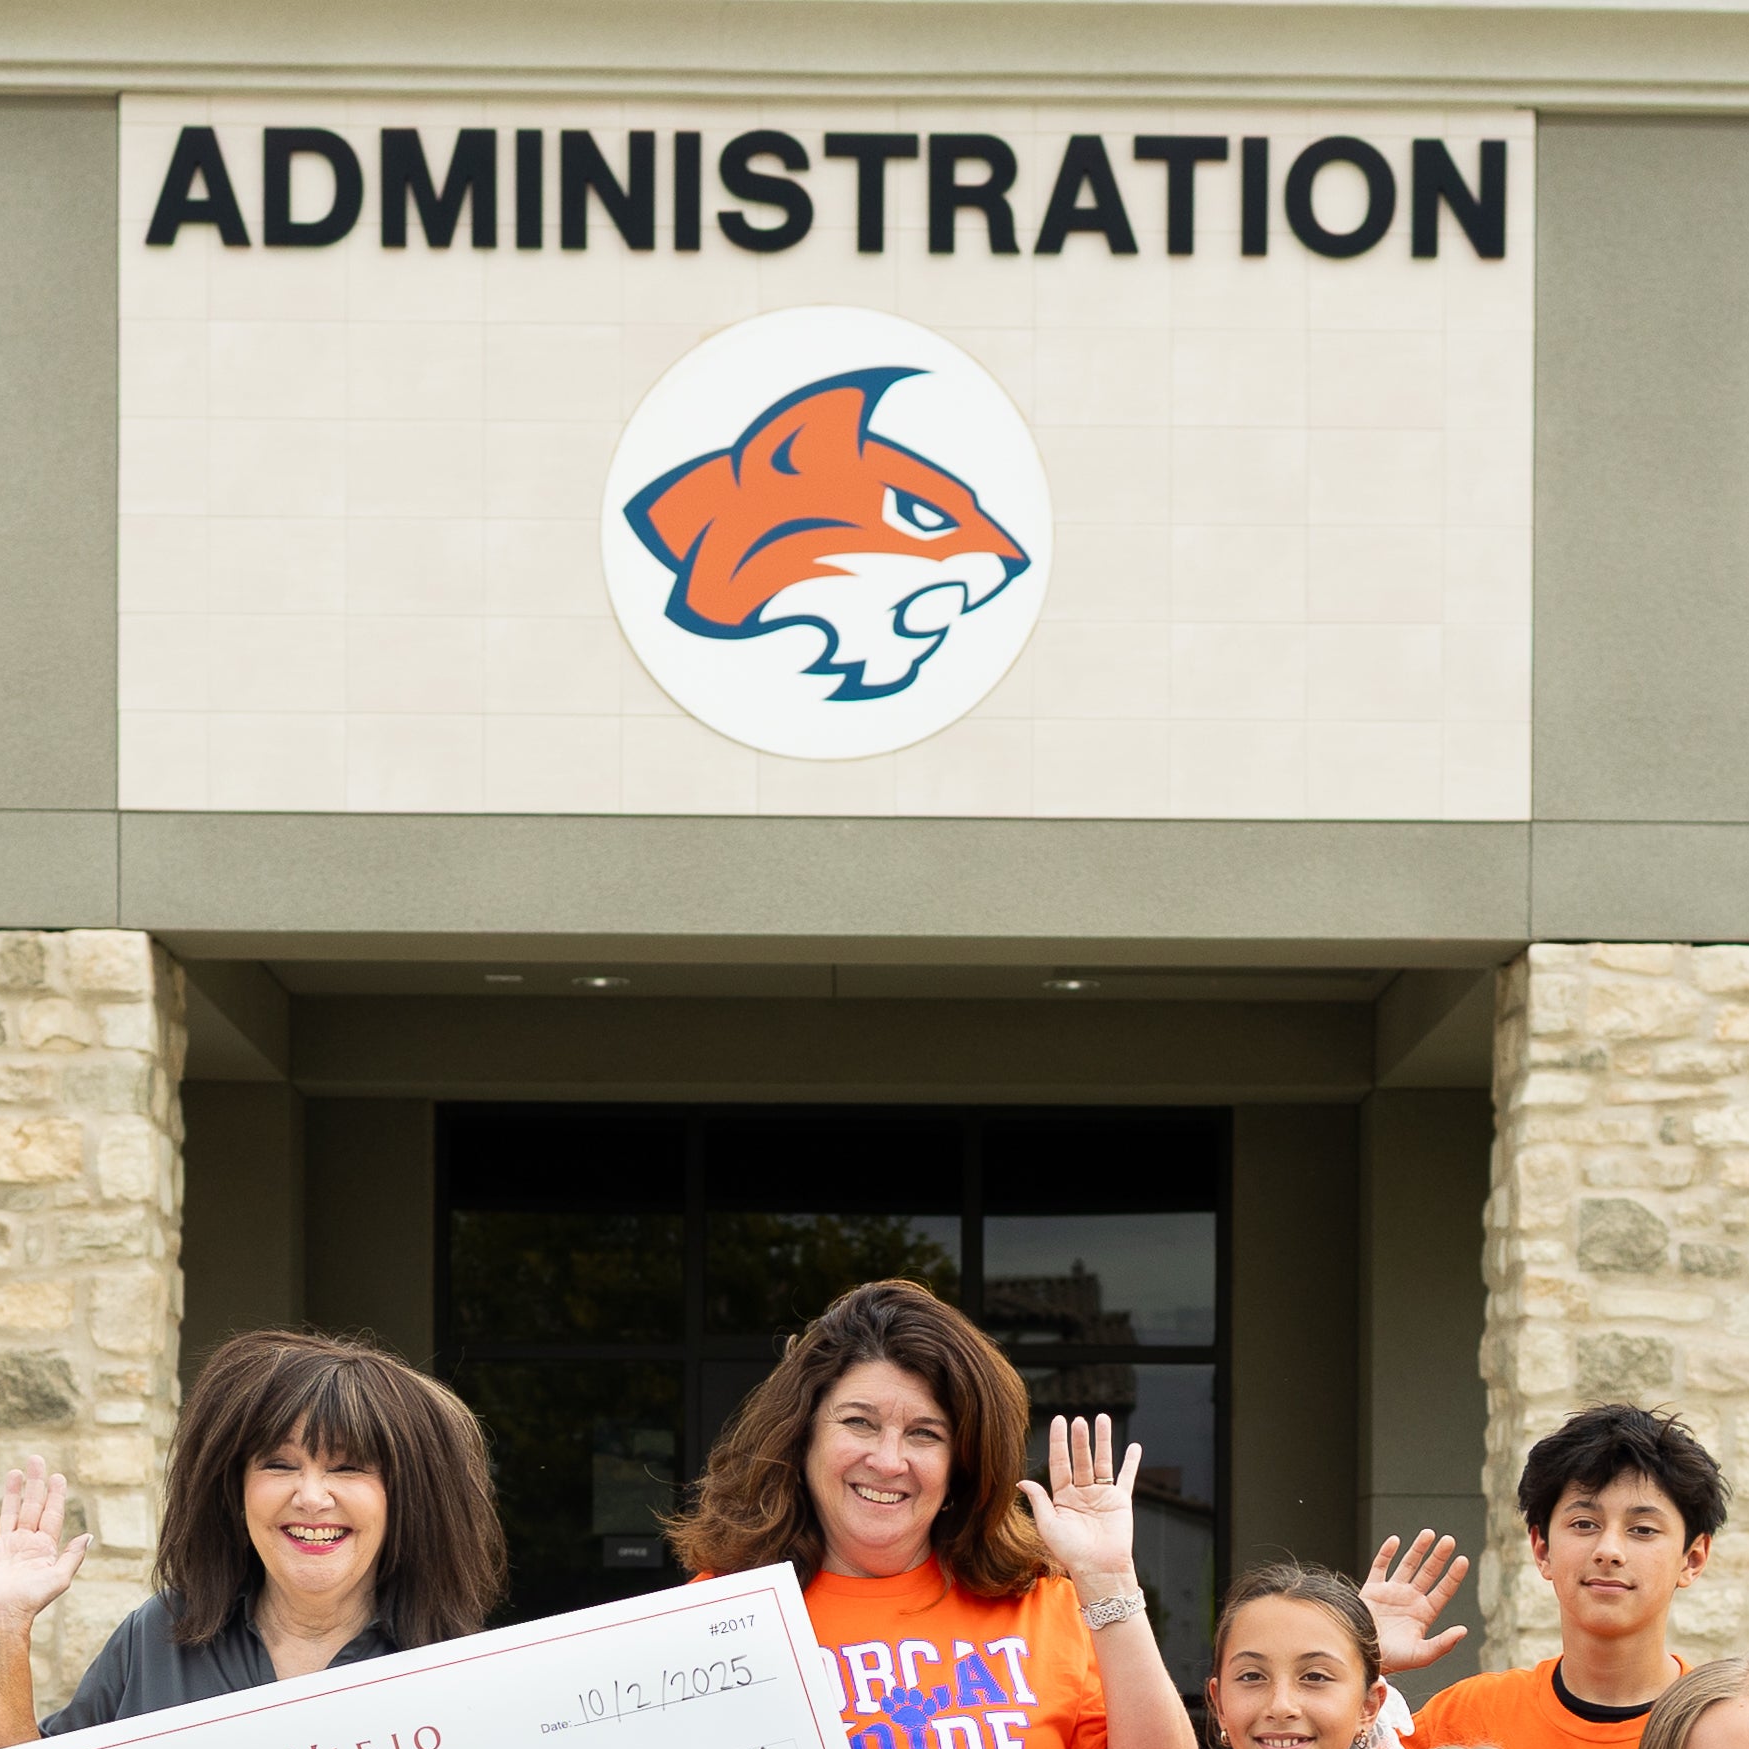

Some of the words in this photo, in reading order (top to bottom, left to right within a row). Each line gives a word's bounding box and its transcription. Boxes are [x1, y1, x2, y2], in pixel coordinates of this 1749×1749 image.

[144, 125, 1508, 260] ADMINISTRATION
[709, 1614, 755, 1636] #2017
[540, 1719, 573, 1734] Date:
